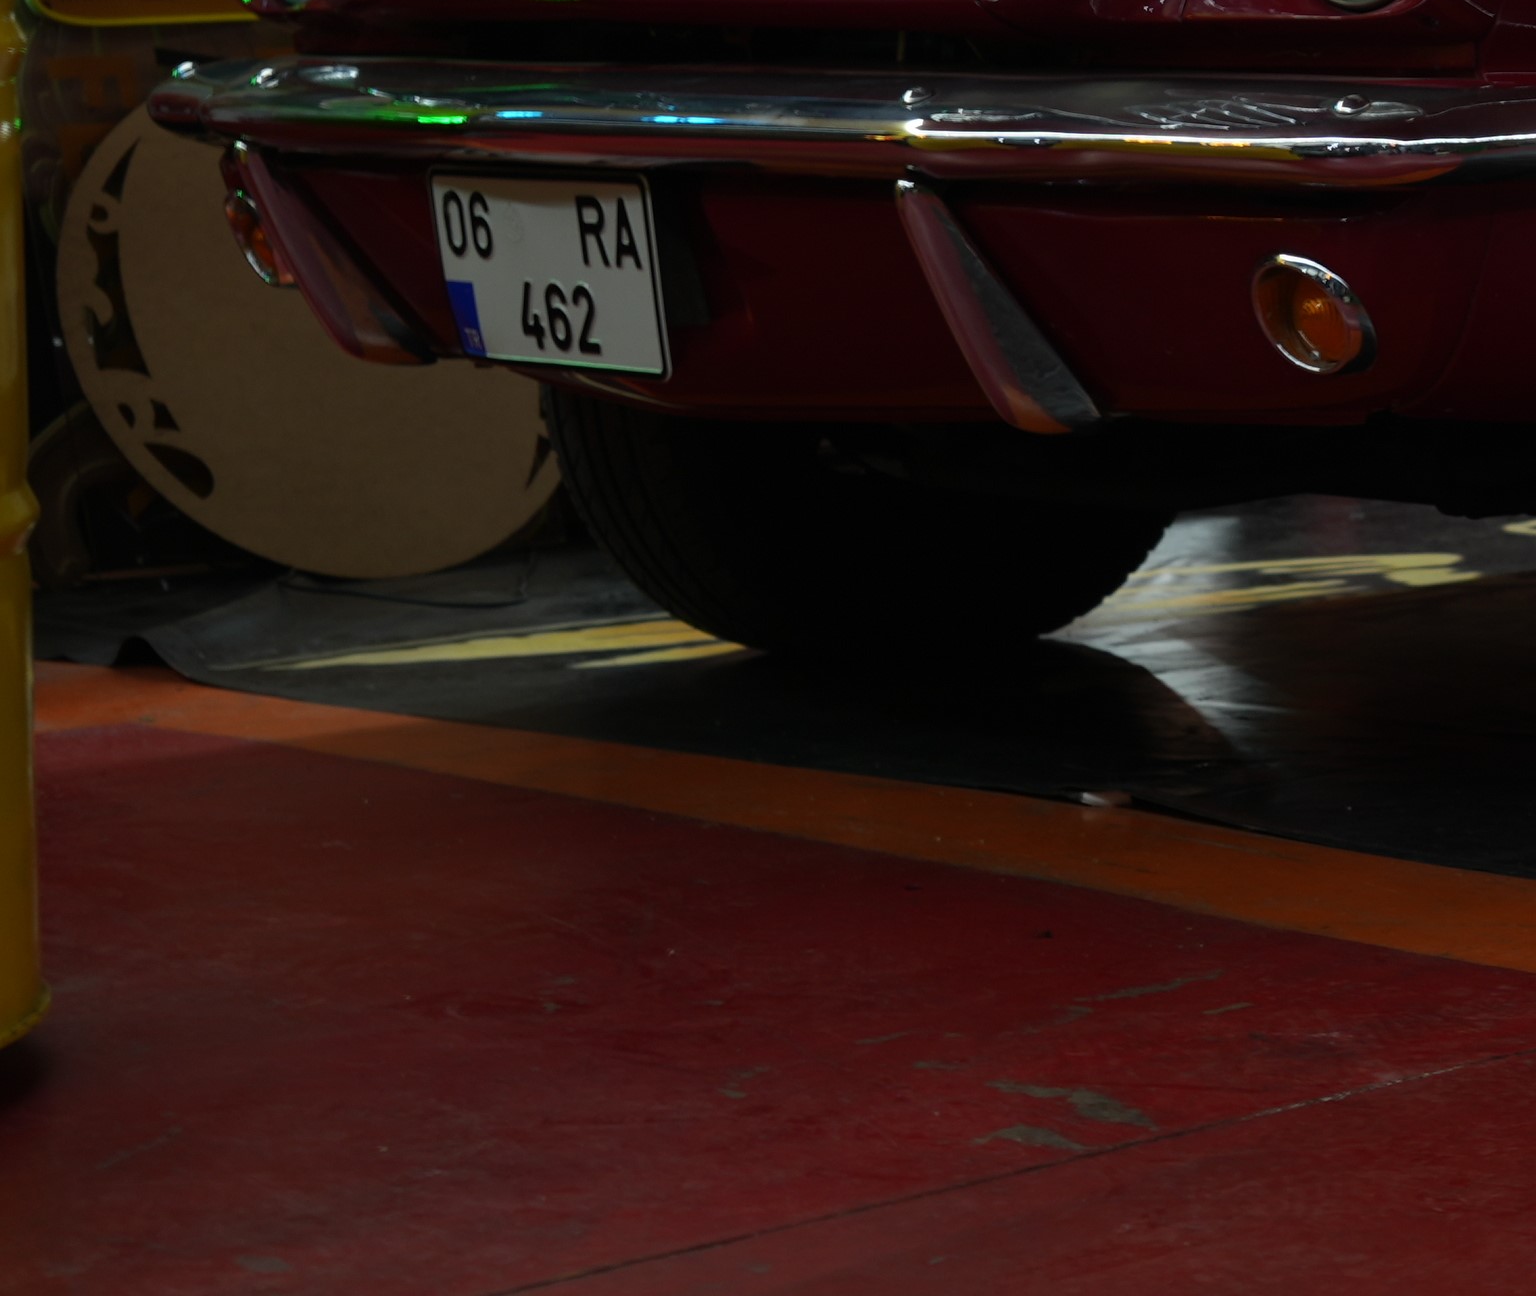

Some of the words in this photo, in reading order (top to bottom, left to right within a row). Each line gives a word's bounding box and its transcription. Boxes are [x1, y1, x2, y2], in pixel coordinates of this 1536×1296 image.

[442, 189, 494, 259] 06
[574, 194, 643, 271] RA
[520, 280, 603, 356] 462
